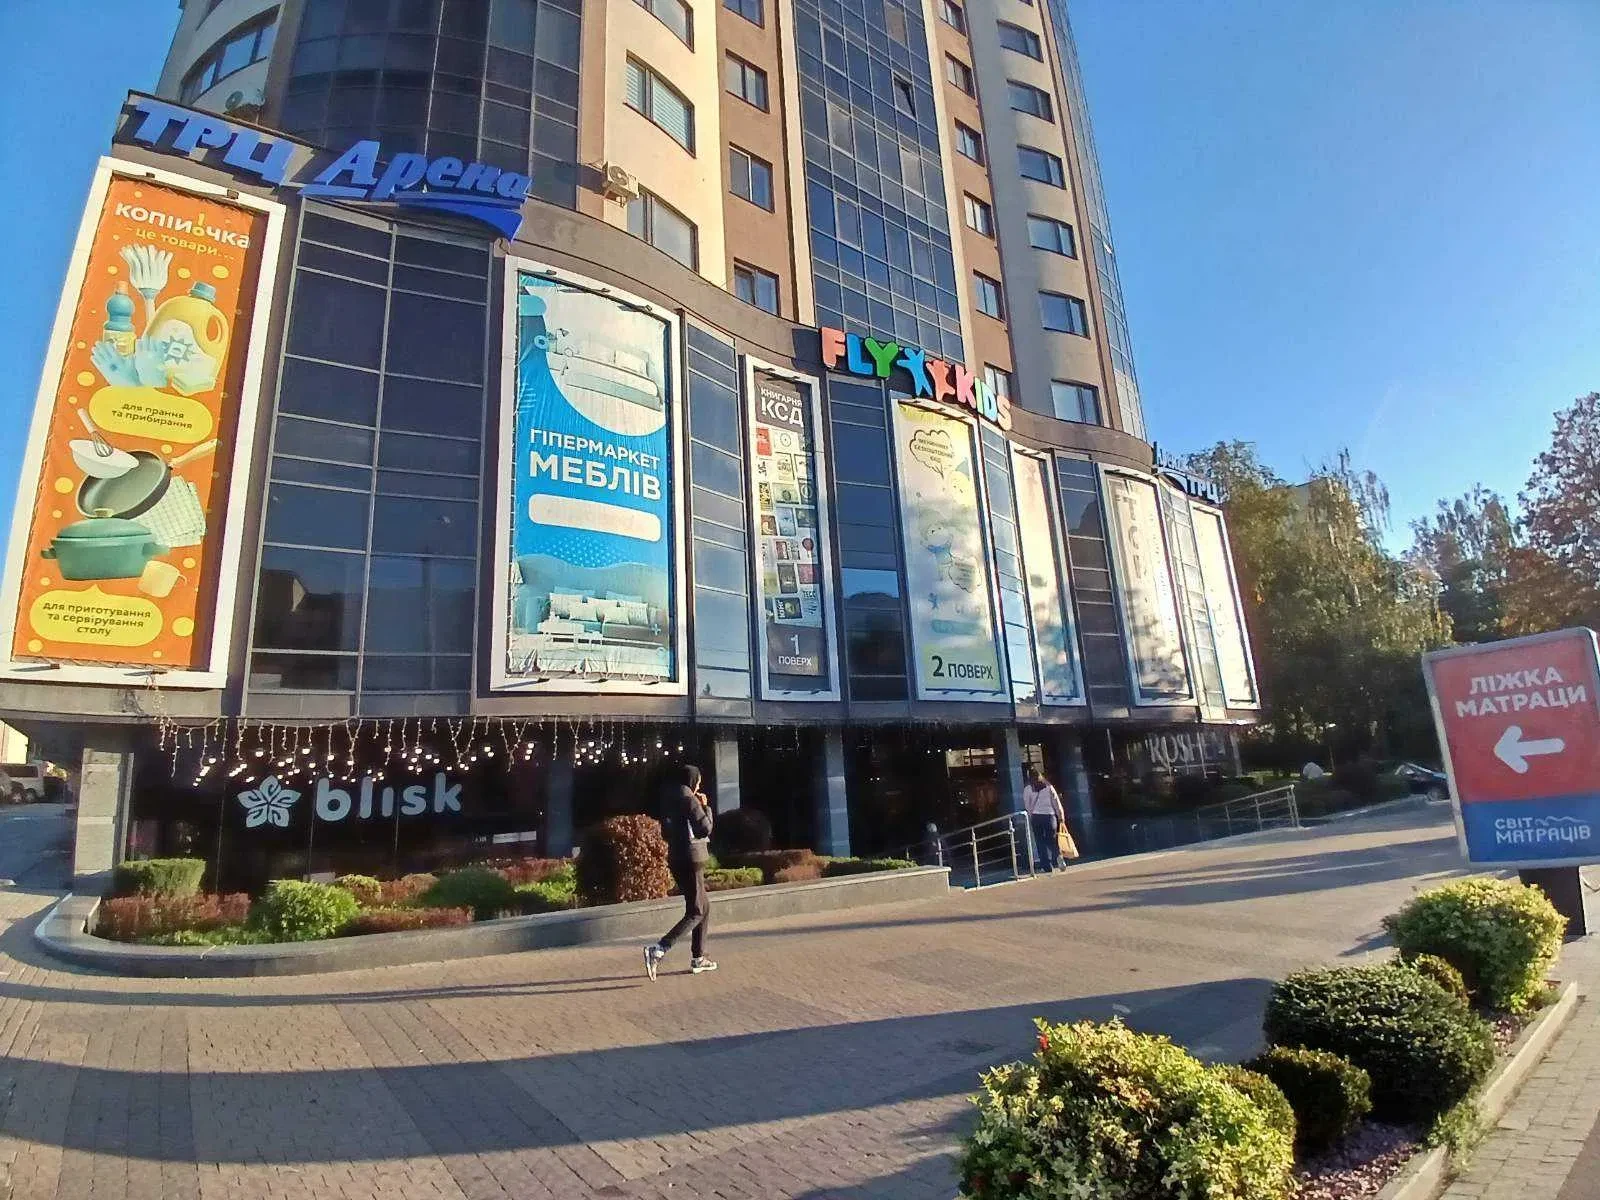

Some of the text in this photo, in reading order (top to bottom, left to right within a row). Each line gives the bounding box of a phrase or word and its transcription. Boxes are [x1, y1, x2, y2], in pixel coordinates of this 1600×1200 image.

[133, 101, 532, 200] ТРЦ Арена
[136, 228, 156, 240] це
[819, 327, 1012, 431] FLY KIDS
[761, 387, 803, 407] КНИГАРНЯ
[112, 410, 193, 429] та прибирання
[122, 403, 184, 418] для прання
[530, 428, 660, 470] ГІПЕРМАРКЕТ
[529, 450, 661, 501] МЕБЛІВ
[43, 602, 151, 618] для приготування
[48, 613, 144, 627] та сервірування
[77, 626, 111, 637] столу
[790, 634, 800, 655] 1
[778, 656, 812, 666] ПОВЕРХ
[931, 655, 994, 680] 2 ПОВЕРХ
[1470, 666, 1563, 695] ЛІЖКА
[1455, 684, 1587, 718] МАТРАЦИ
[316, 772, 463, 822] blisk
[1494, 817, 1534, 830] СВІТ
[1495, 824, 1591, 844] МАТРАЦІВ
